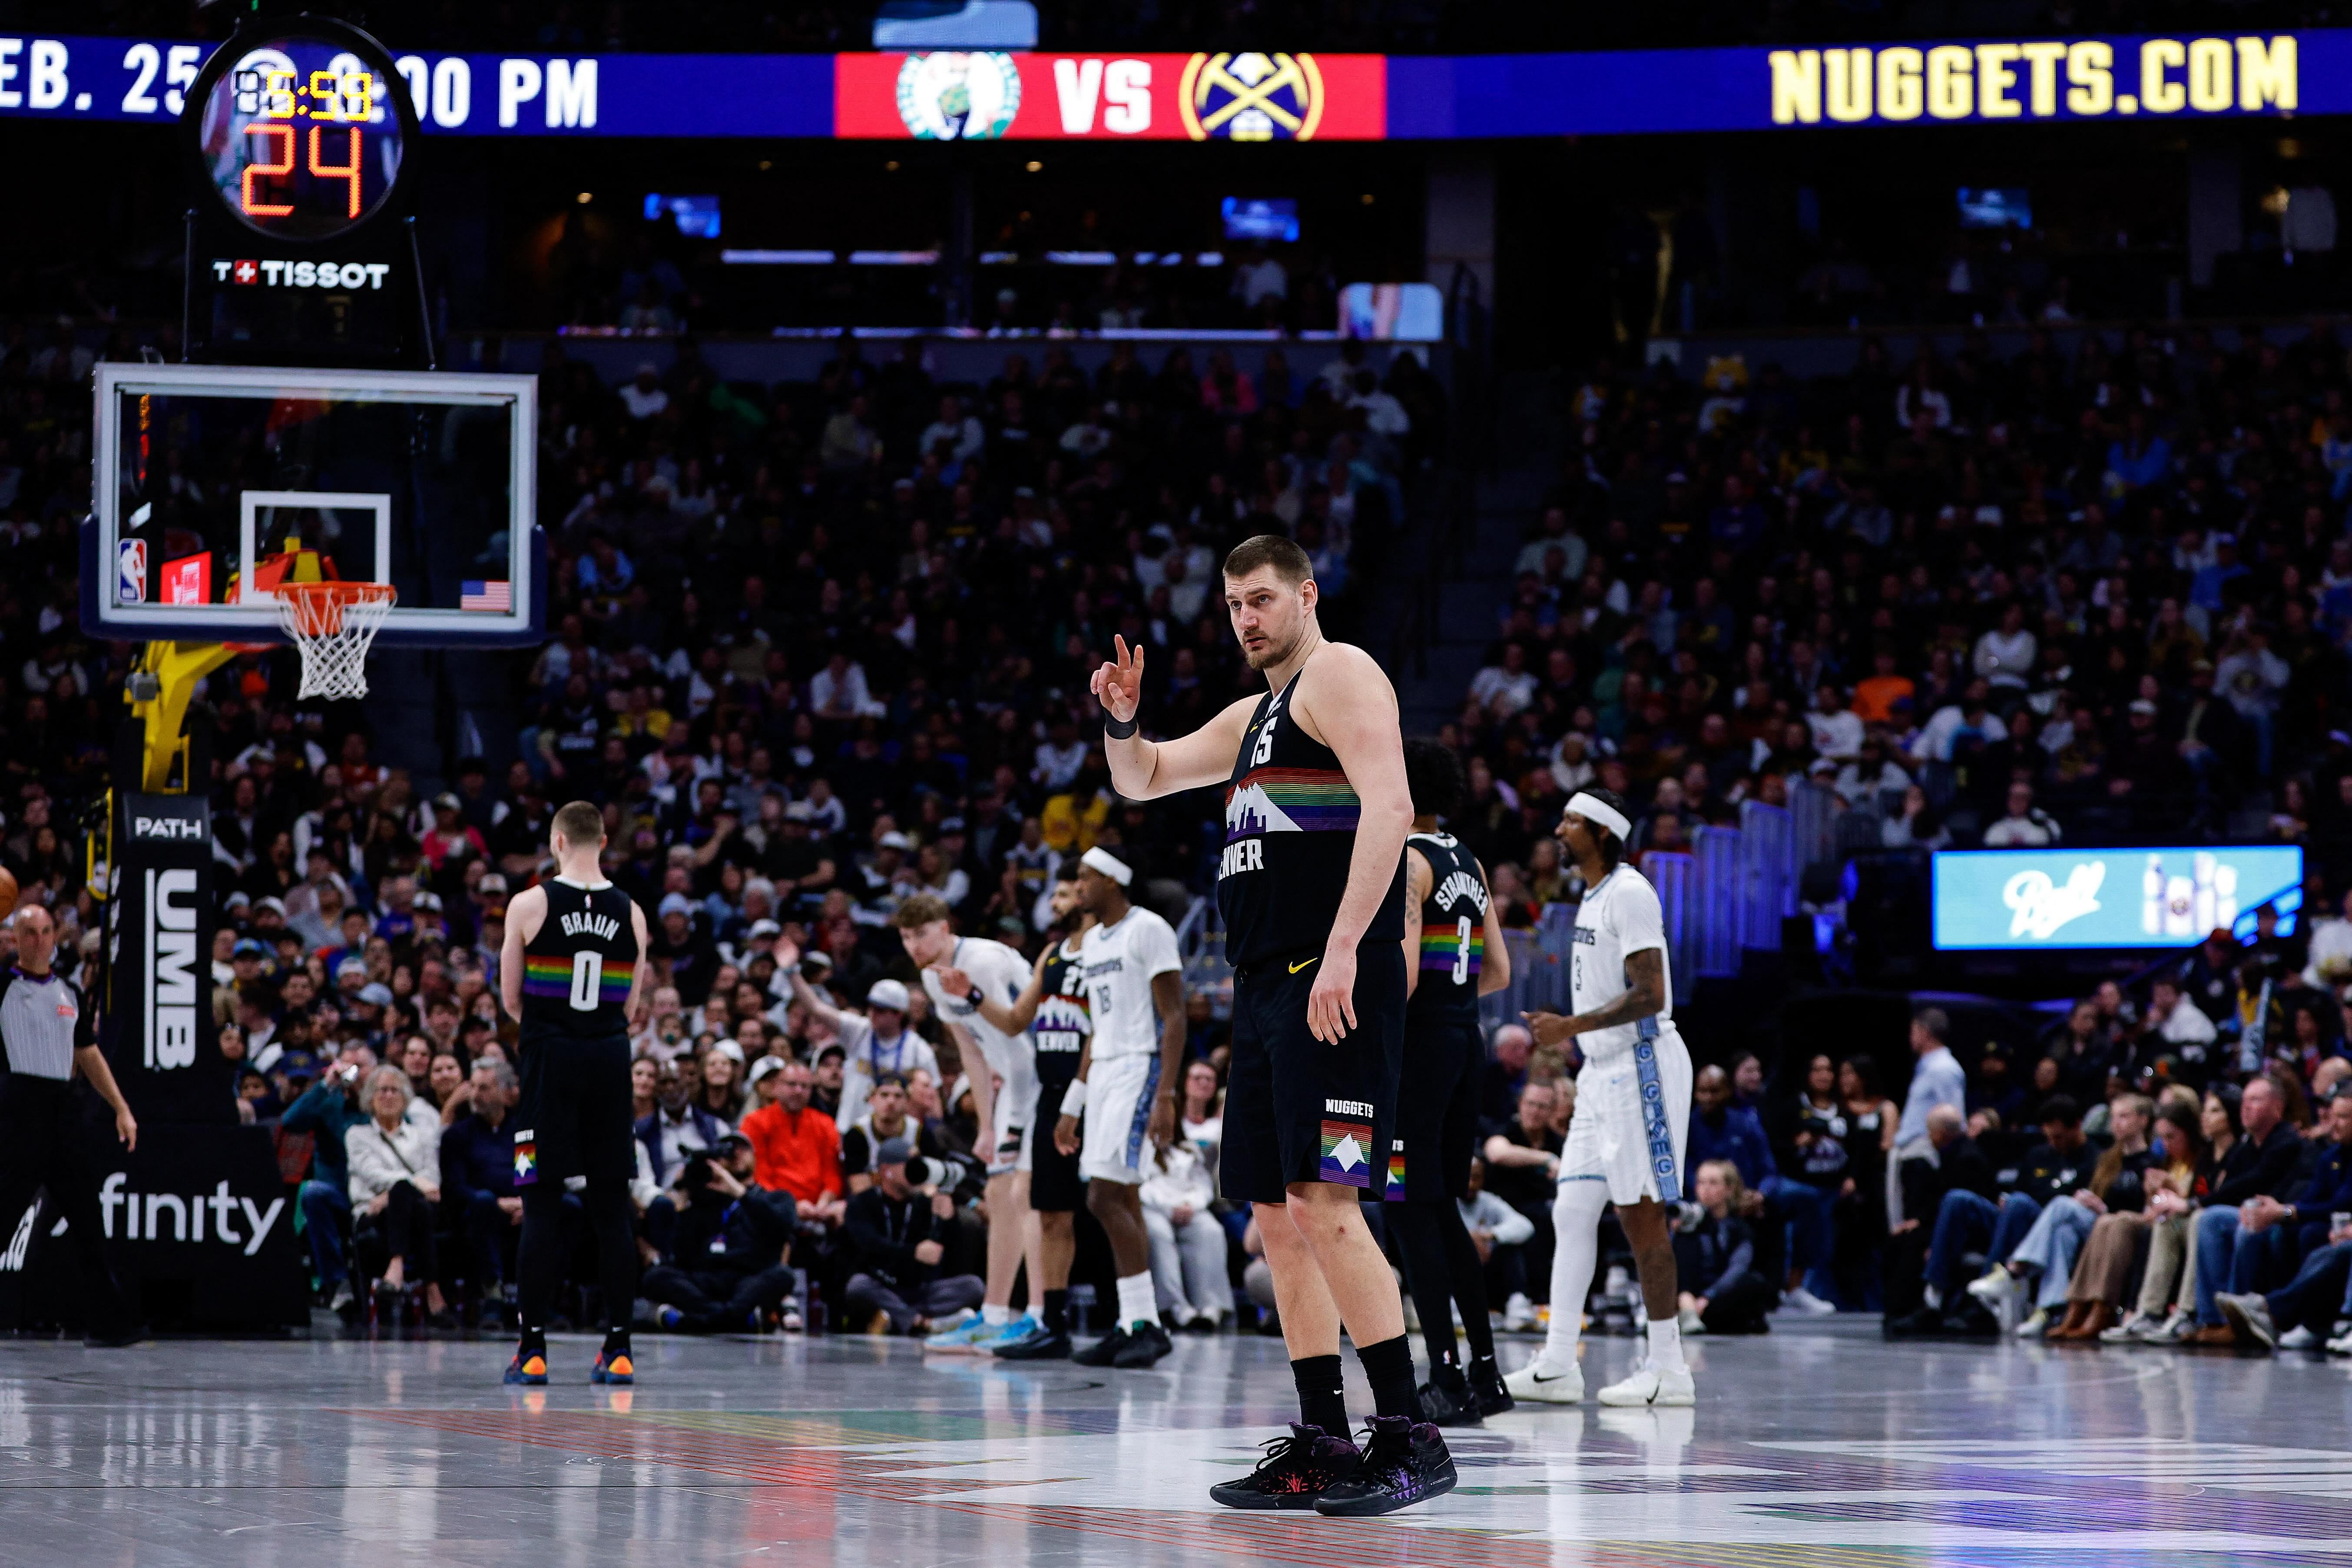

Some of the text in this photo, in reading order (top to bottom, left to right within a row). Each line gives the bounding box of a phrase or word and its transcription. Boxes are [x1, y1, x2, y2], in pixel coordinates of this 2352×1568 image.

[122, 43, 201, 116] 25
[499, 59, 598, 128] PM
[1053, 59, 1152, 134] VS
[1768, 36, 2298, 124] NUGGETS.COM
[242, 123, 361, 219] 24
[260, 260, 390, 290] TISSOT
[135, 816, 202, 839] PATH
[560, 912, 619, 941] BRAUN
[1452, 915, 1471, 985] 3
[156, 869, 197, 1070] UMB
[570, 950, 603, 1011] 0
[1326, 1099, 1373, 1118] NUGGETS
[50, 1172, 286, 1255] finity
